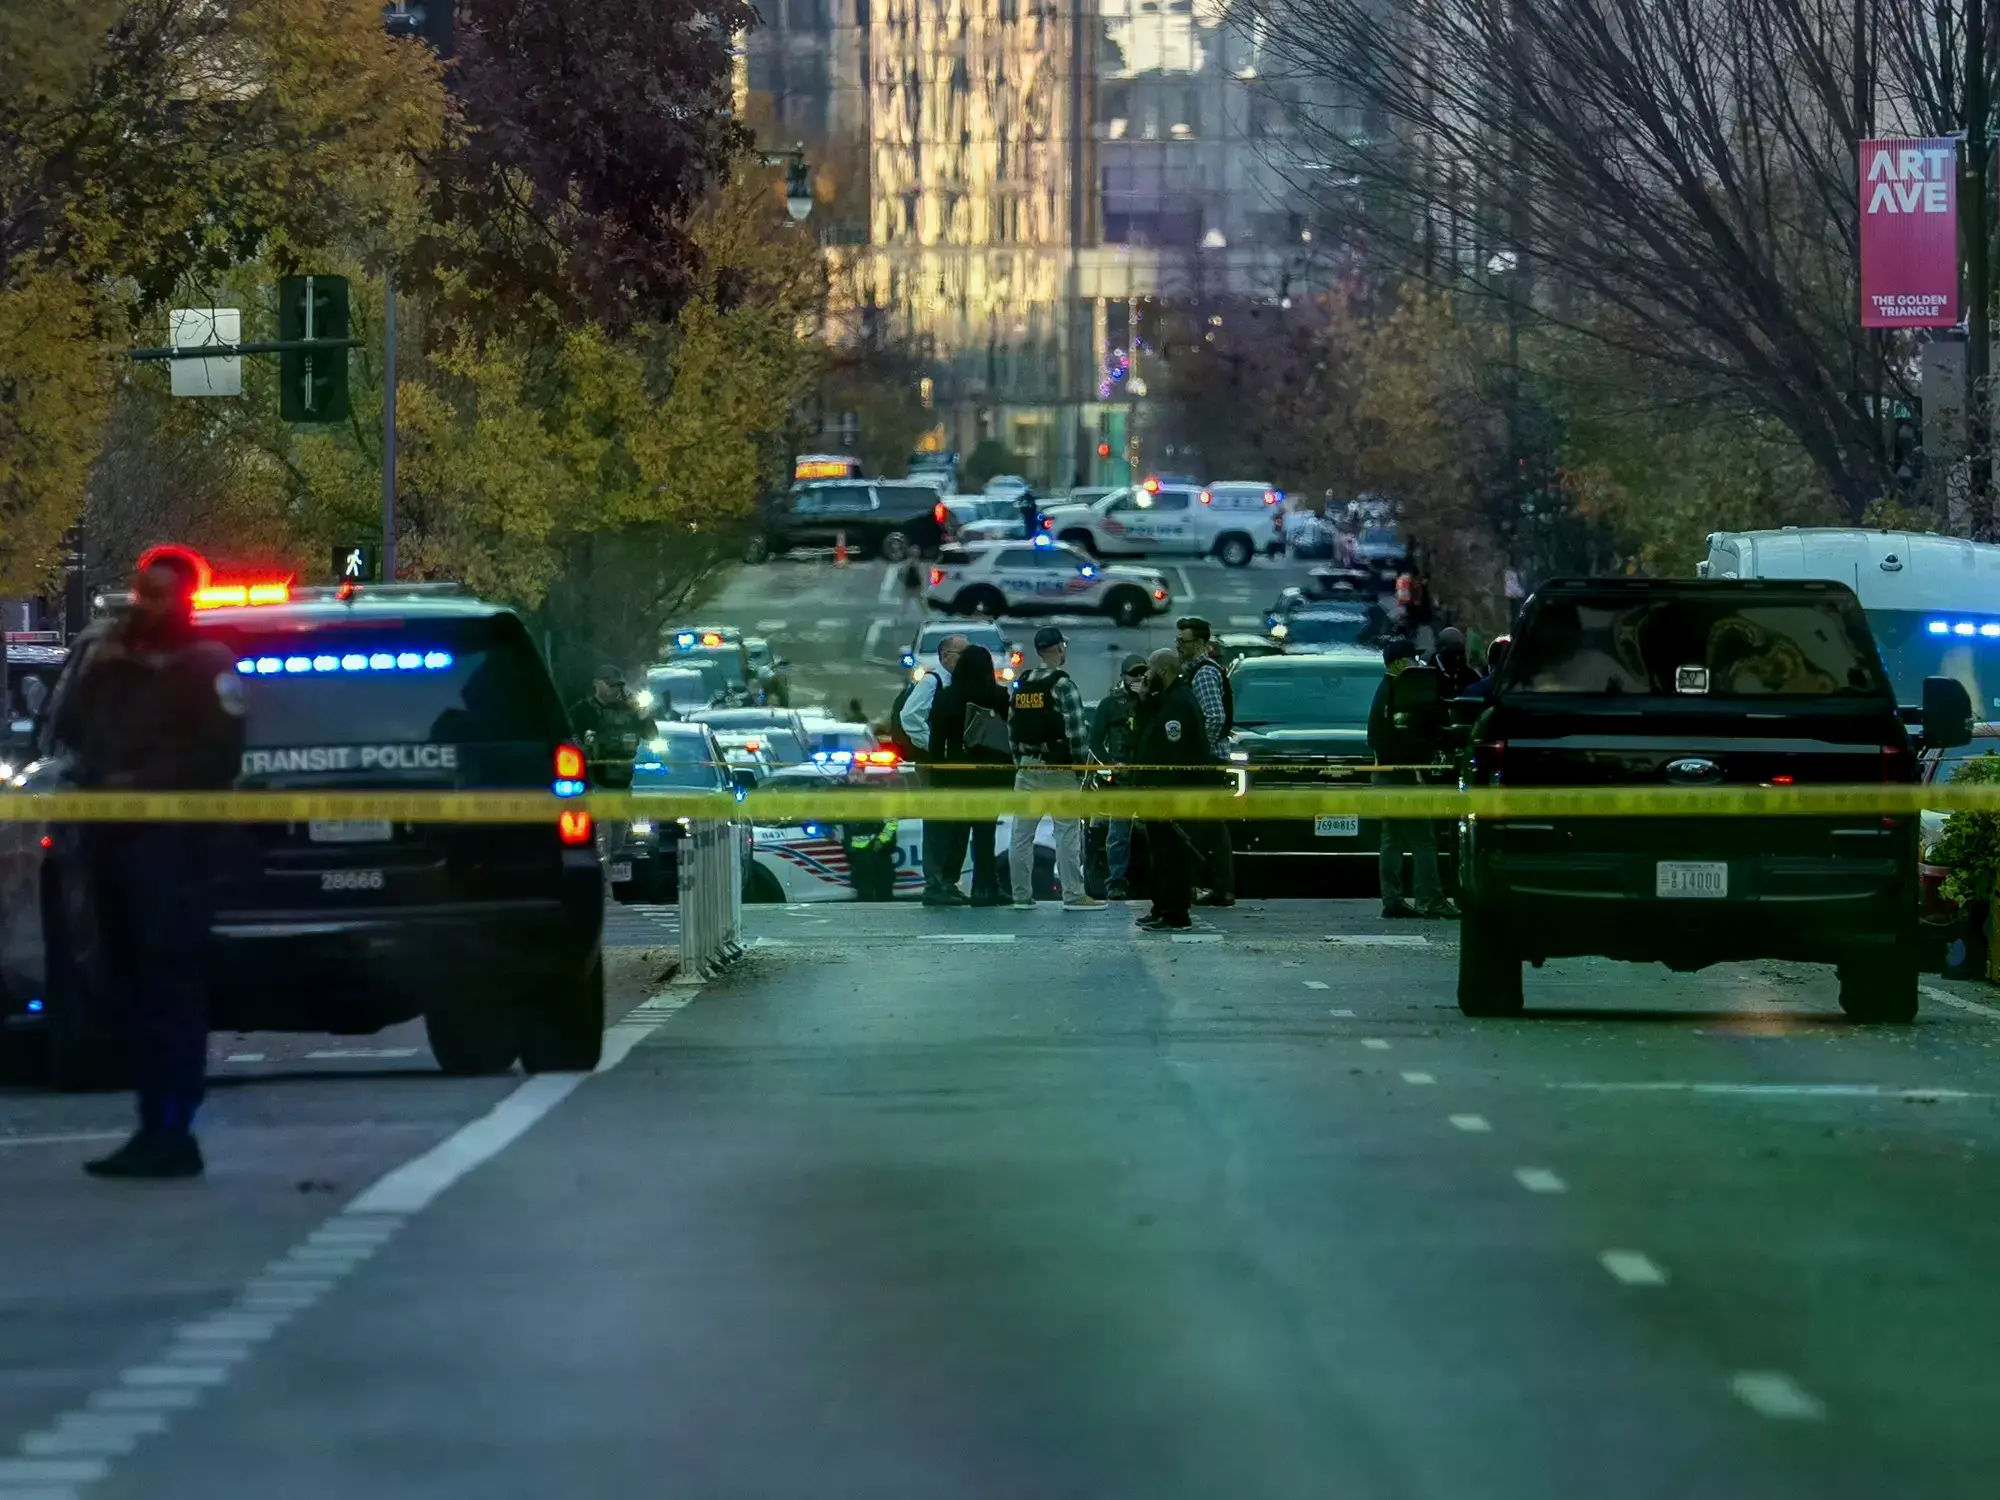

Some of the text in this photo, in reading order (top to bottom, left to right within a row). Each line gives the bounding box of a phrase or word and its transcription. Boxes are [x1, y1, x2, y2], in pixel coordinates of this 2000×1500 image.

[1868, 149, 1949, 180] ART
[1868, 182, 1947, 213] AVE
[1871, 294, 1947, 306] THE GOLDEN
[1880, 306, 1939, 316] TRIANGLE
[1015, 692, 1044, 705] POLICE
[360, 744, 457, 769] POLICE
